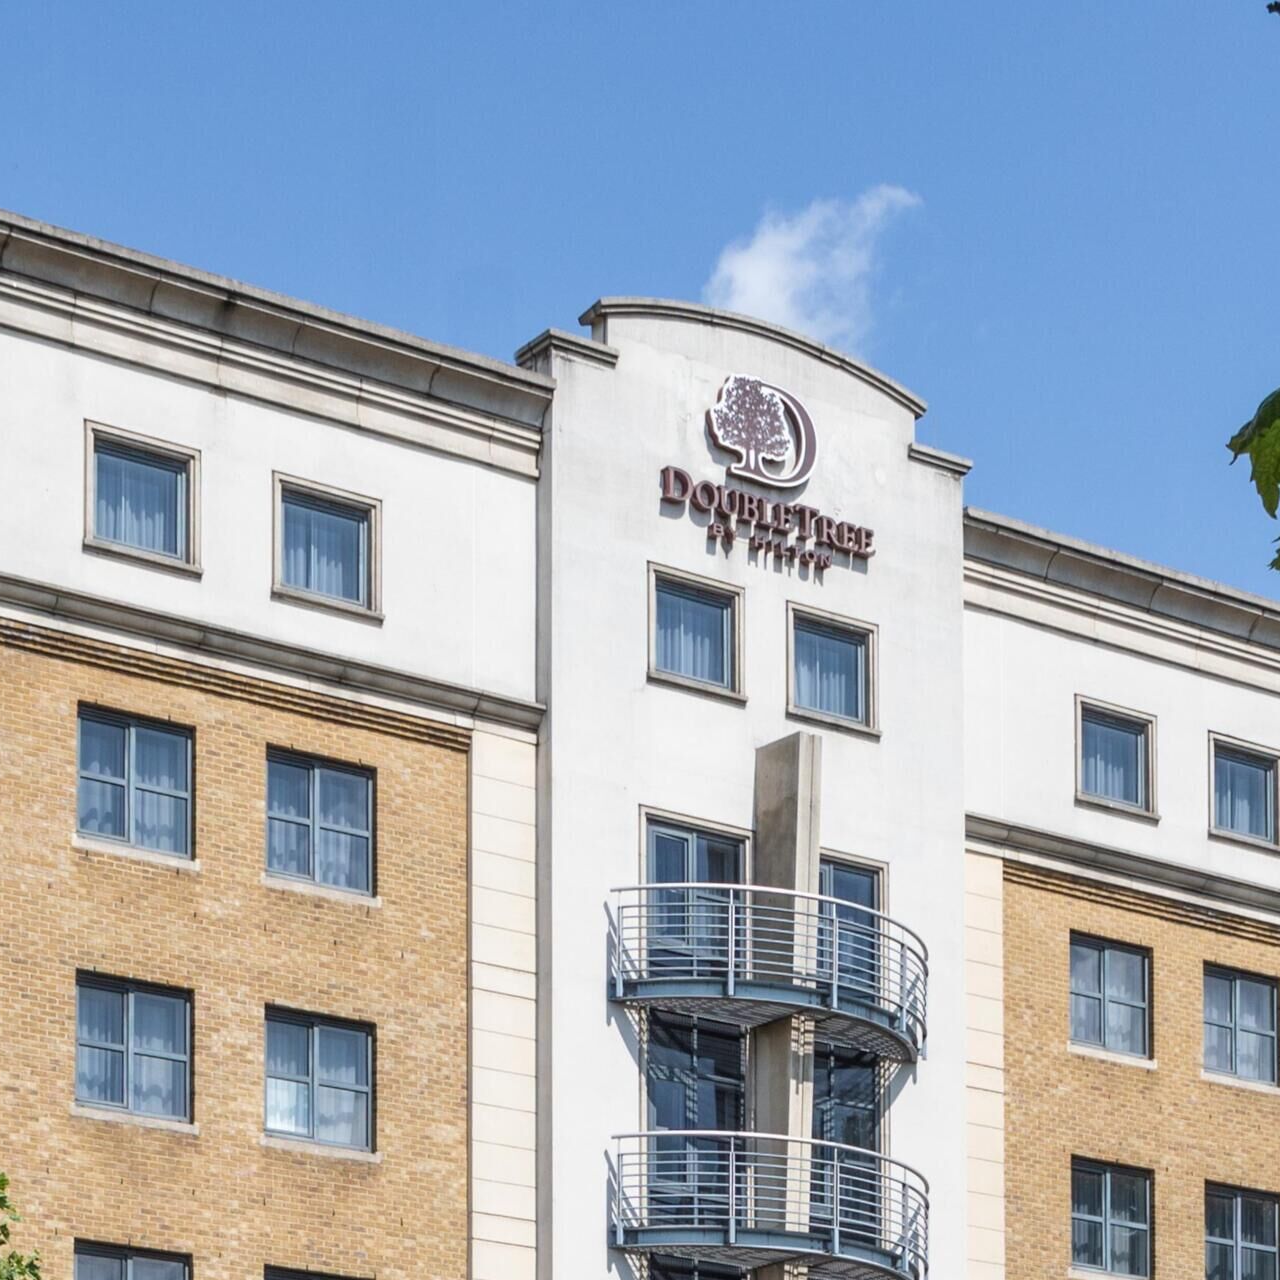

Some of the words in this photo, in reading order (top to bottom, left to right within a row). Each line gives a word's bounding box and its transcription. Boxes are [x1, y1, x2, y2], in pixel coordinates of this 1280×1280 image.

[660, 465, 876, 559] DOUBLETREE
[708, 522, 736, 542] BY
[750, 534, 833, 569] HILTON
